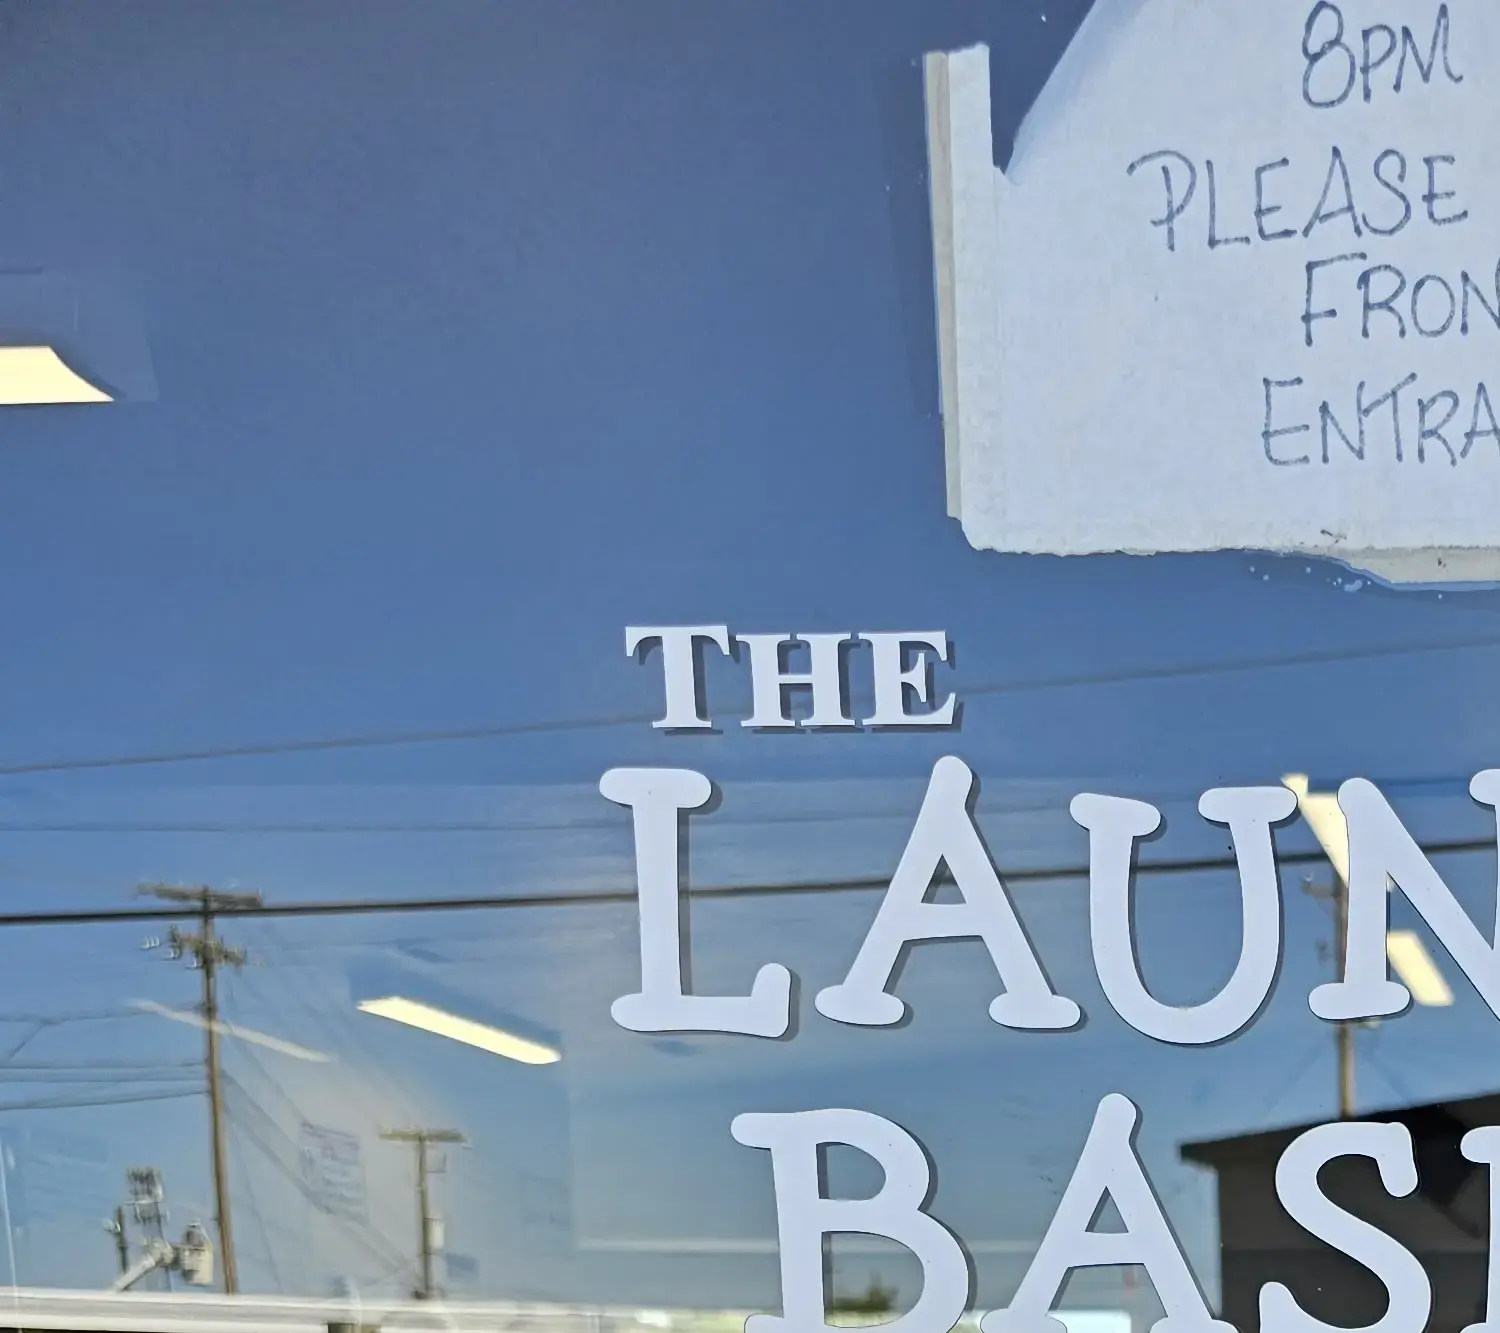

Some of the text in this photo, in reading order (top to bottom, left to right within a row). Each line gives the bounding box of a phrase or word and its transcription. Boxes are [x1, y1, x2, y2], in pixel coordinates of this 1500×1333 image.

[1300, 1, 1464, 109] 8PM
[1126, 145, 1470, 251] PLEASE
[625, 625, 957, 729] THE
